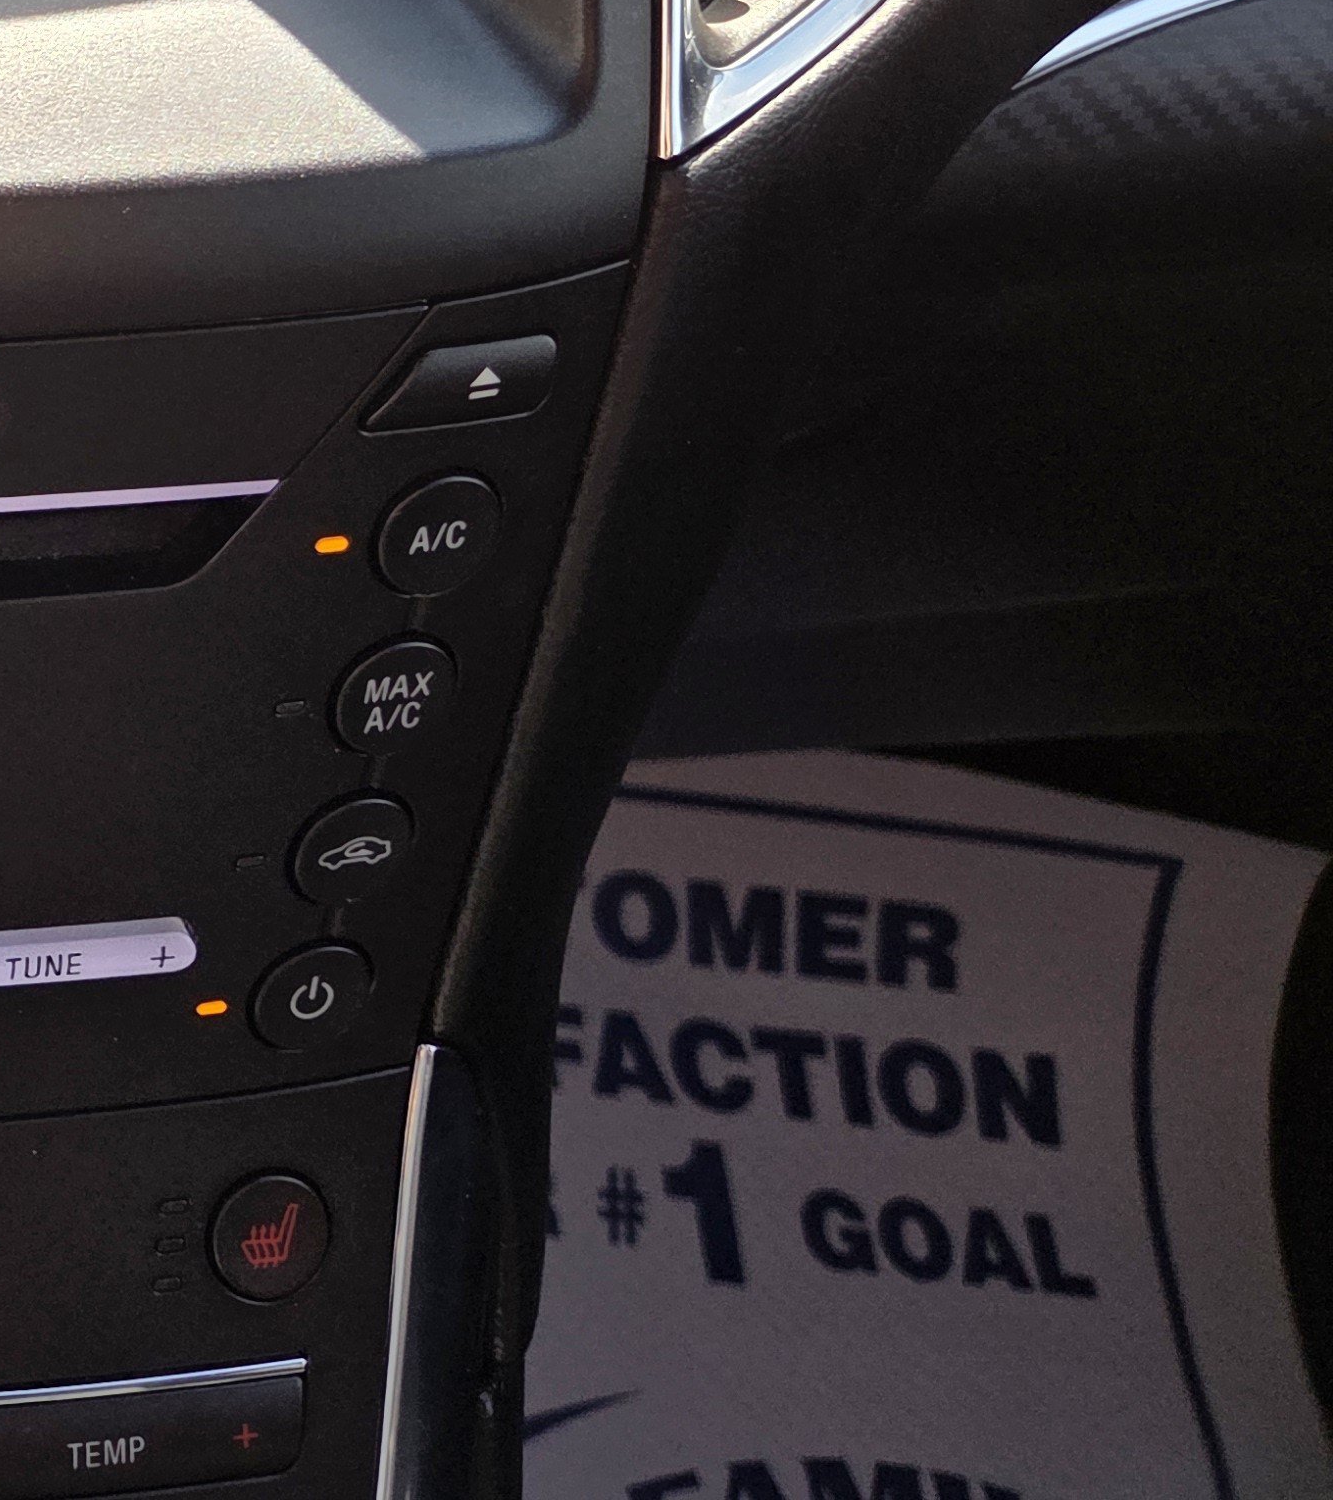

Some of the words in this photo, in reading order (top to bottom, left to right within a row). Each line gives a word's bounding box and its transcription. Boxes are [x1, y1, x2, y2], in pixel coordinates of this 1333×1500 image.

[408, 520, 467, 556] A/C
[363, 671, 434, 705] MAX
[363, 701, 421, 735] A/C
[591, 868, 961, 992] OMER
[5, 950, 82, 978] TUNE
[799, 1188, 1098, 1298] GOAL
[67, 1435, 146, 1470] TEMP
